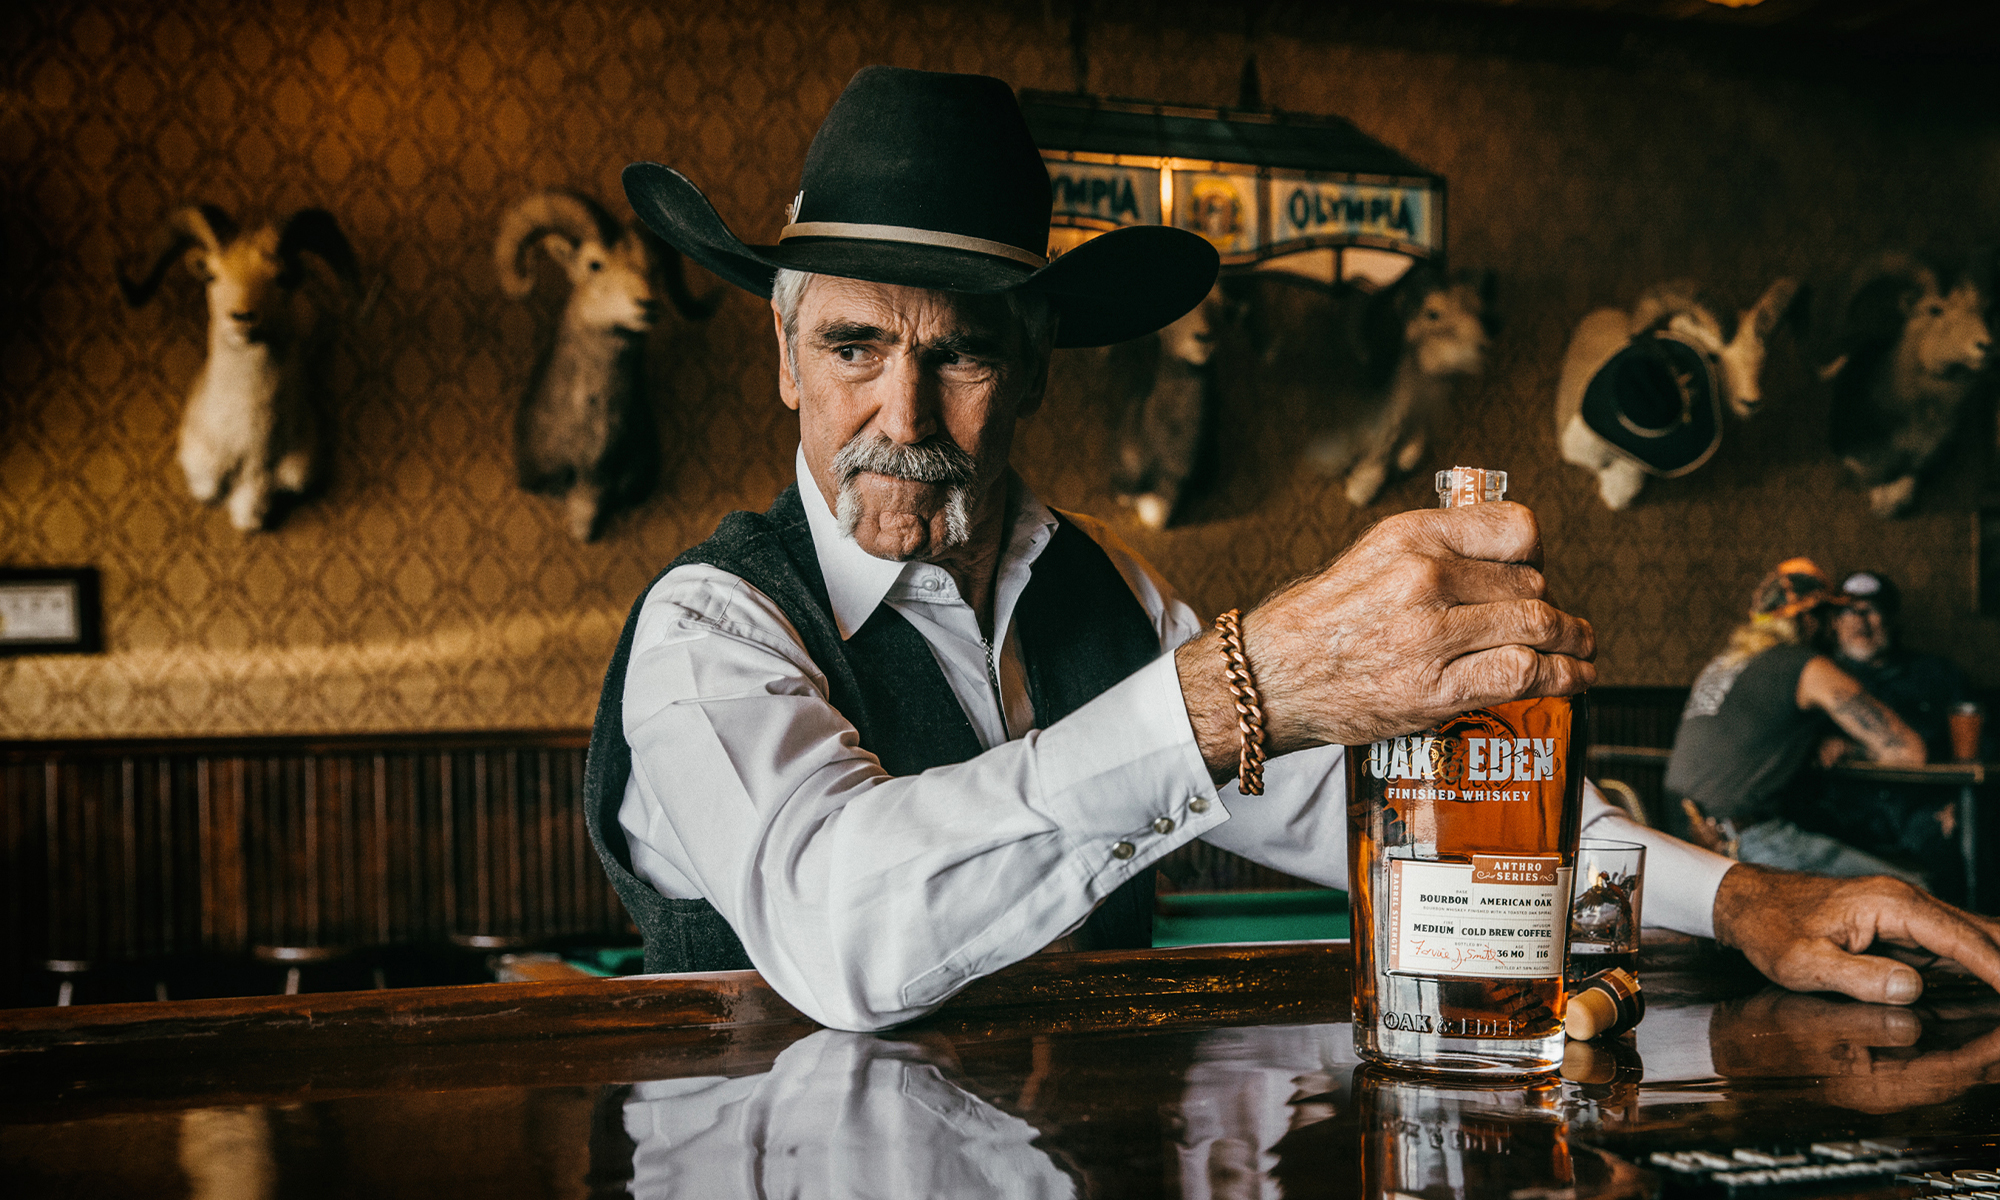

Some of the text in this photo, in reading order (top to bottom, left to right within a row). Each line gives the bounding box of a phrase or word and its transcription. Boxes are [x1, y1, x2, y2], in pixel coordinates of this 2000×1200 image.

[1289, 187, 1415, 236] OLYMPIA
[1371, 737, 1436, 779] OAK
[1467, 738, 1555, 781] EDEN
[1388, 788, 1531, 802] FINISHED WHISKEY
[1493, 861, 1542, 872] ANTHRO
[1496, 872, 1539, 881] SERIES
[1420, 894, 1468, 905] BOURBON
[1480, 897, 1552, 907] AMERICAN OAK
[1413, 924, 1454, 934] MEDIUM
[1461, 927, 1551, 938] COLD BREW COFFEE
[1497, 950, 1509, 958] 36
[1384, 1011, 1432, 1034] OAK
